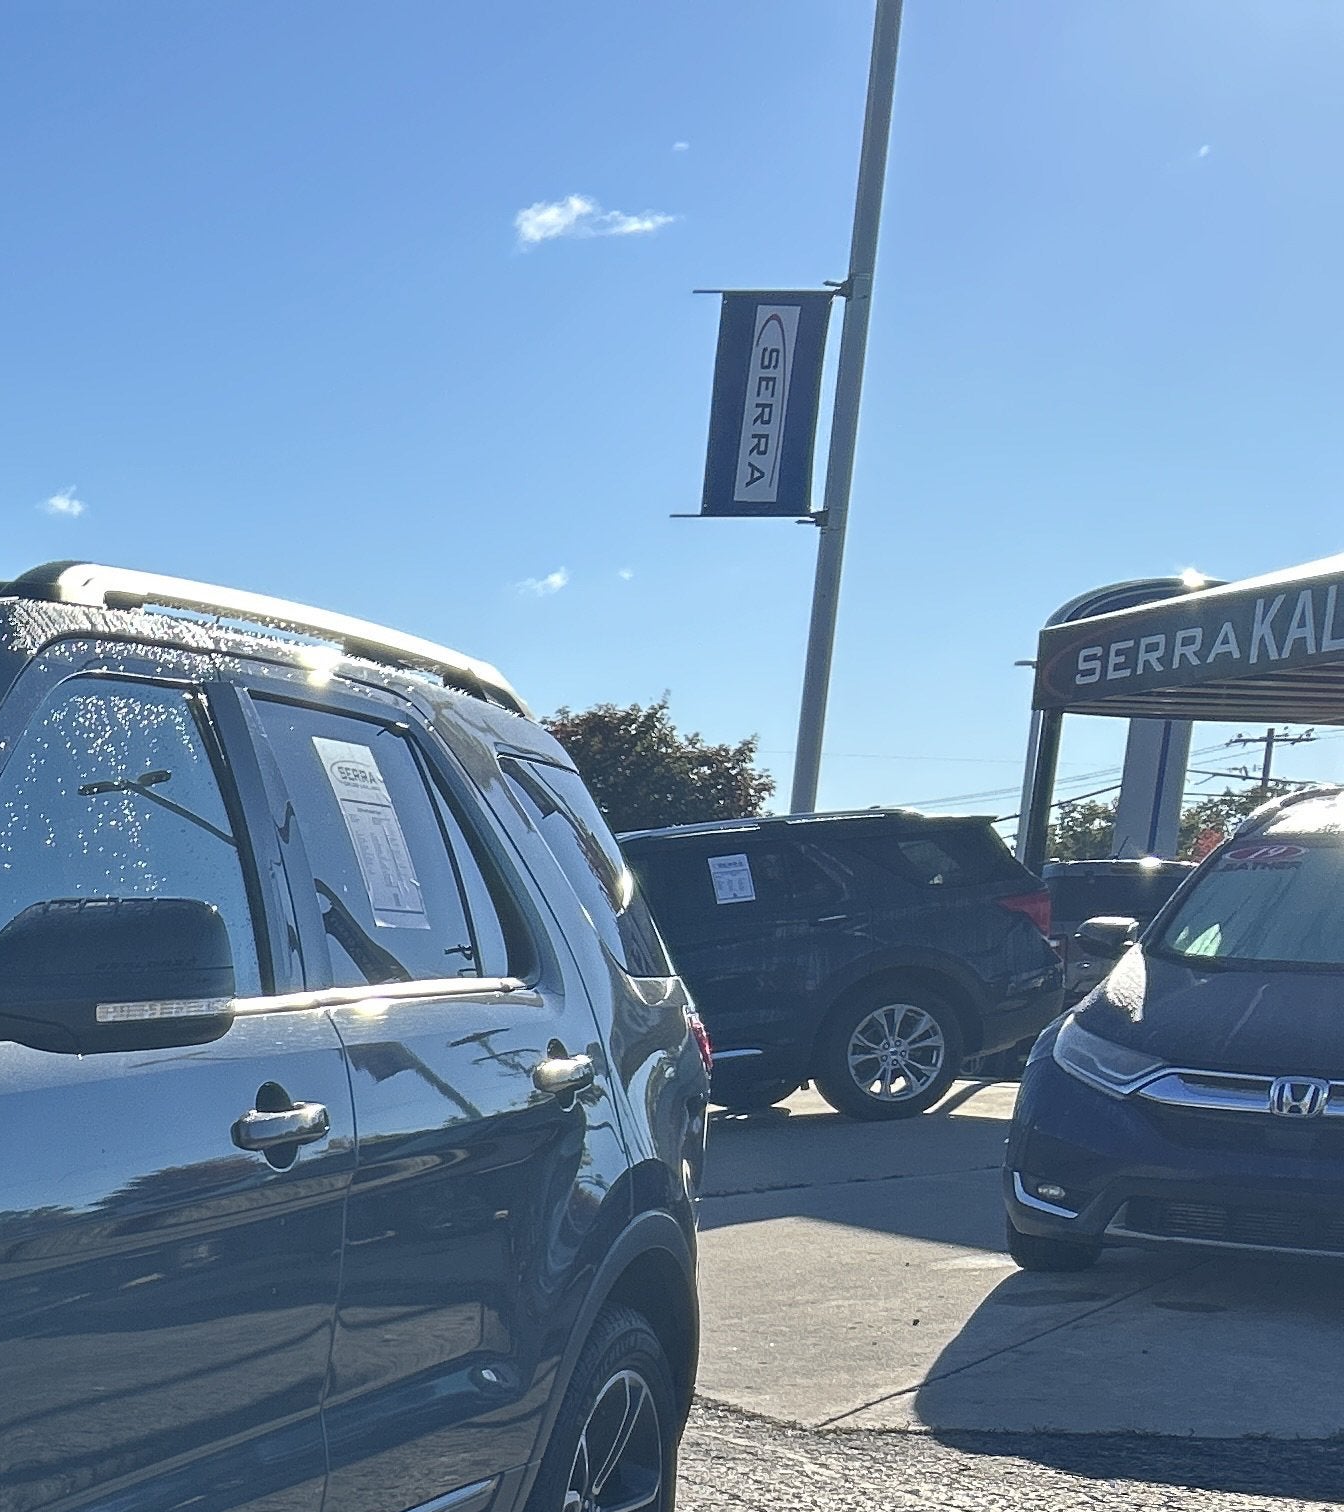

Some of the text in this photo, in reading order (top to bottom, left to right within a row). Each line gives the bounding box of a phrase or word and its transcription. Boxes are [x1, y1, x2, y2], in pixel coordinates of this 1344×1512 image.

[745, 346, 780, 488] SERRA
[1075, 621, 1241, 686] SERRA
[337, 766, 378, 785] SERRA
